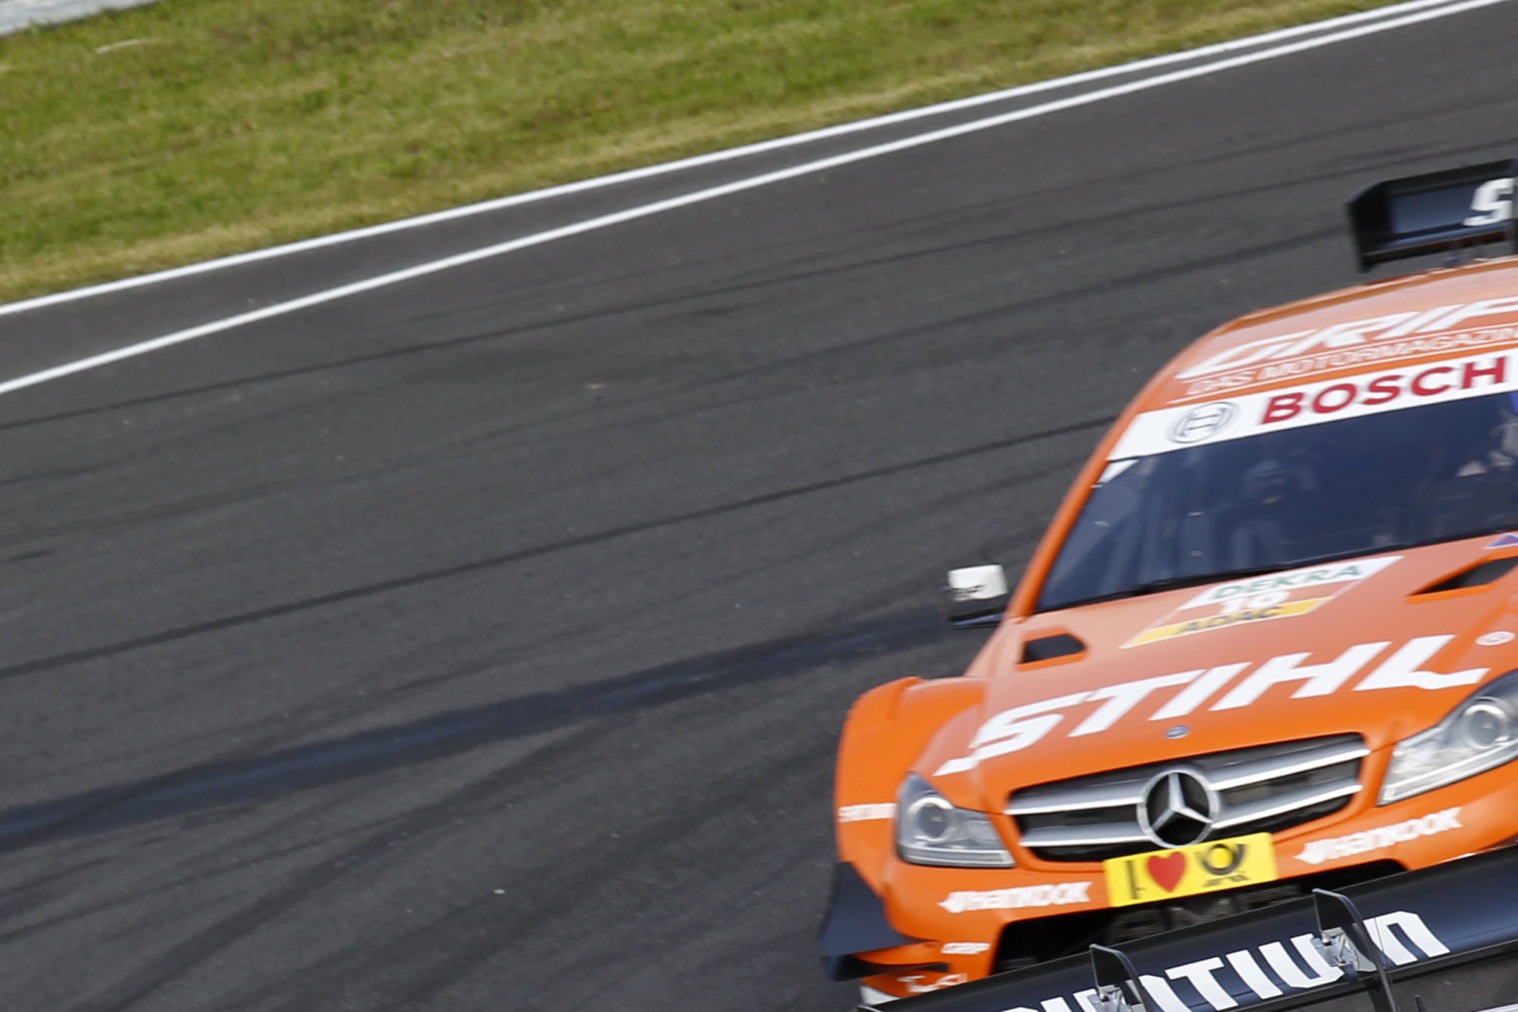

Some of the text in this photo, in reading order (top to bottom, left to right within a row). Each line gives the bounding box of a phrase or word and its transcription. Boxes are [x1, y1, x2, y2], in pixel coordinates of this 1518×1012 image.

[1260, 356, 1508, 425] BOSCH
[1212, 565, 1362, 599] DEKRA
[933, 635, 1489, 776] STIHL
